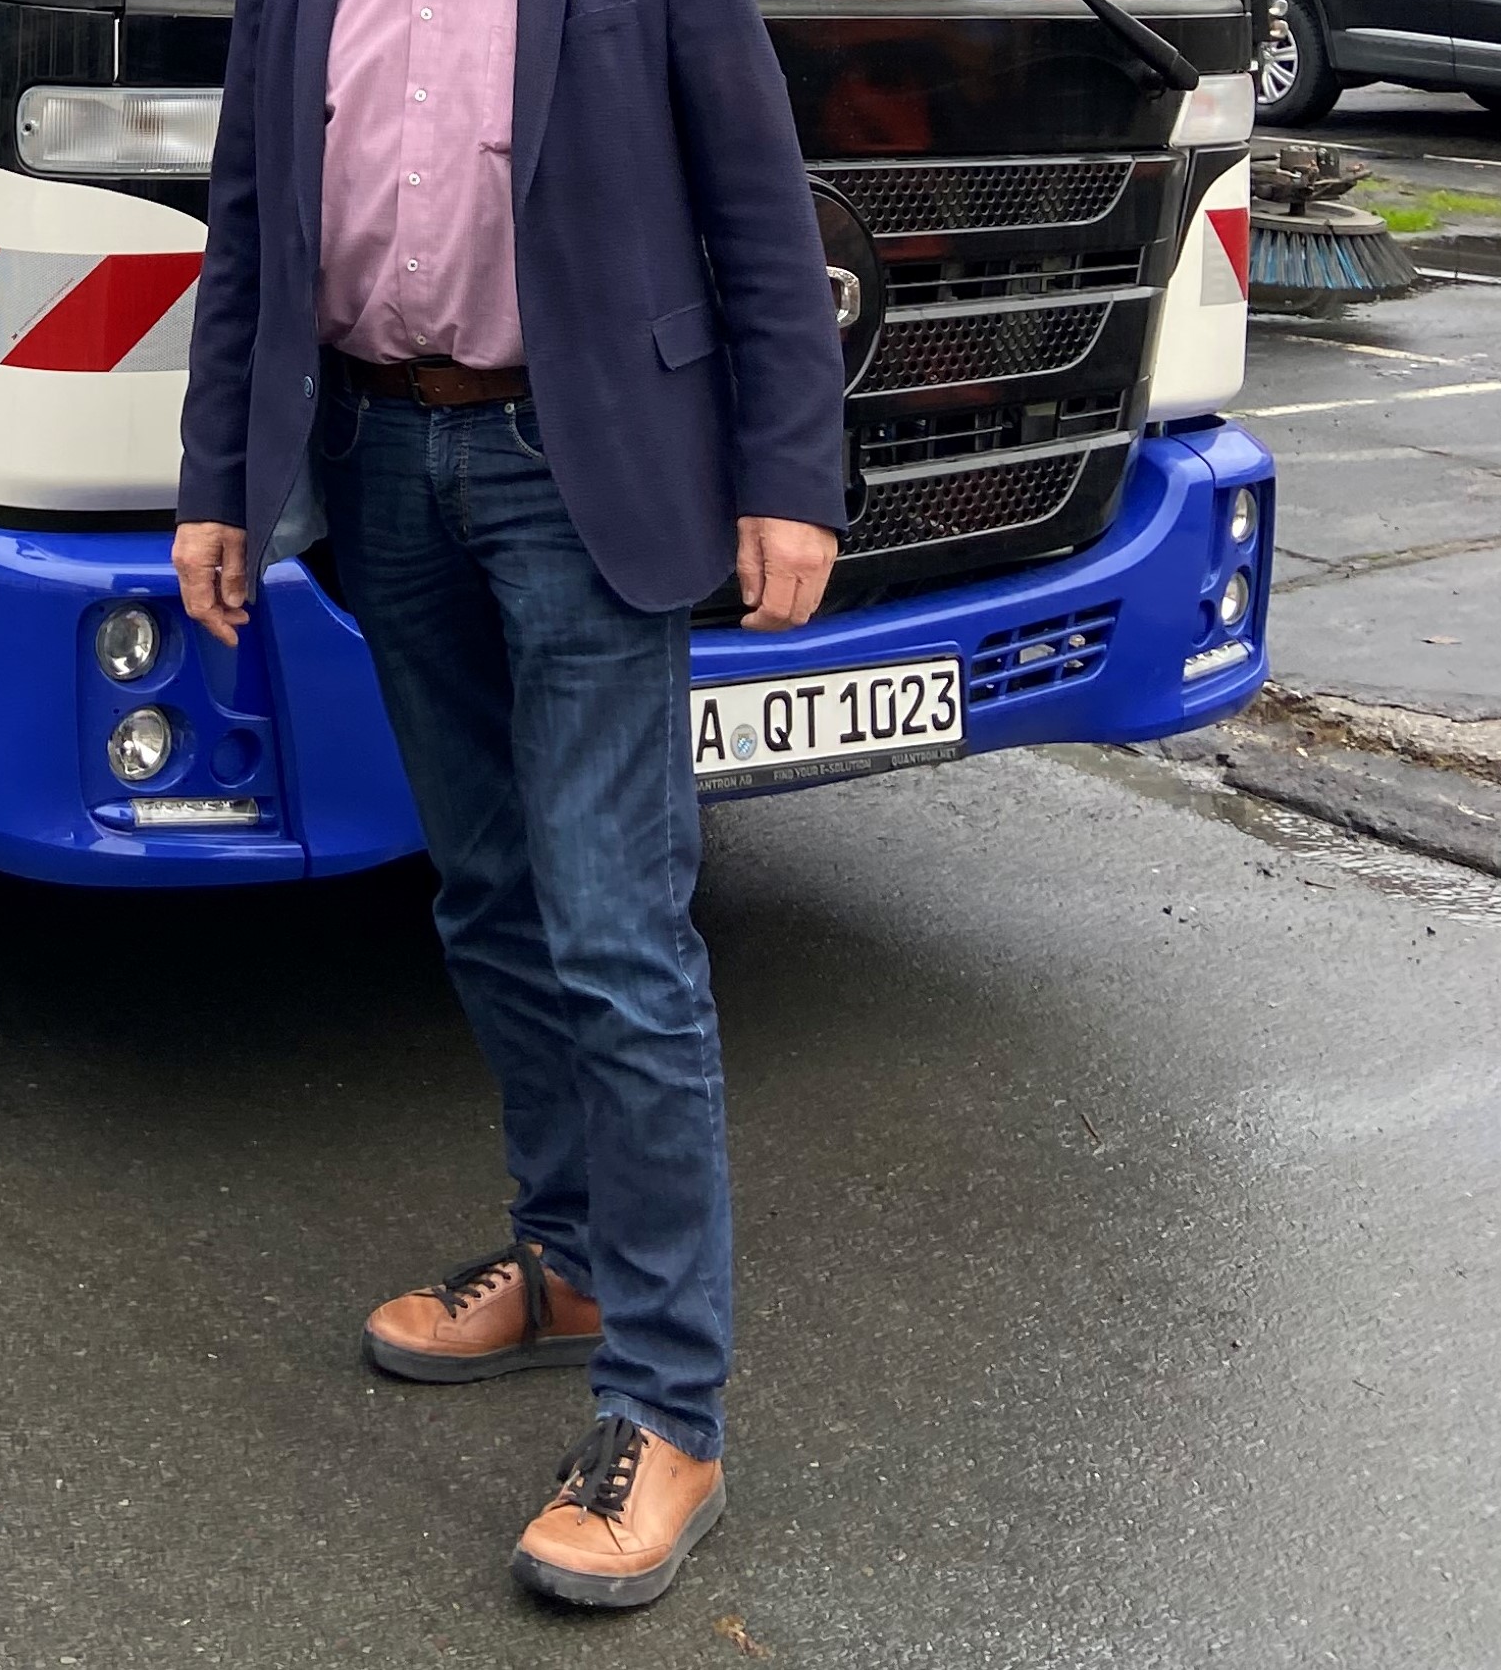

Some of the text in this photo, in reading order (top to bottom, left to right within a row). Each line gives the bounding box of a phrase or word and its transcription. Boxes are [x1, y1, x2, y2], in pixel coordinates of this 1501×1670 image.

[696, 670, 956, 763] A QT 1023
[773, 769, 793, 781] FIND
[794, 766, 819, 779] YOUR
